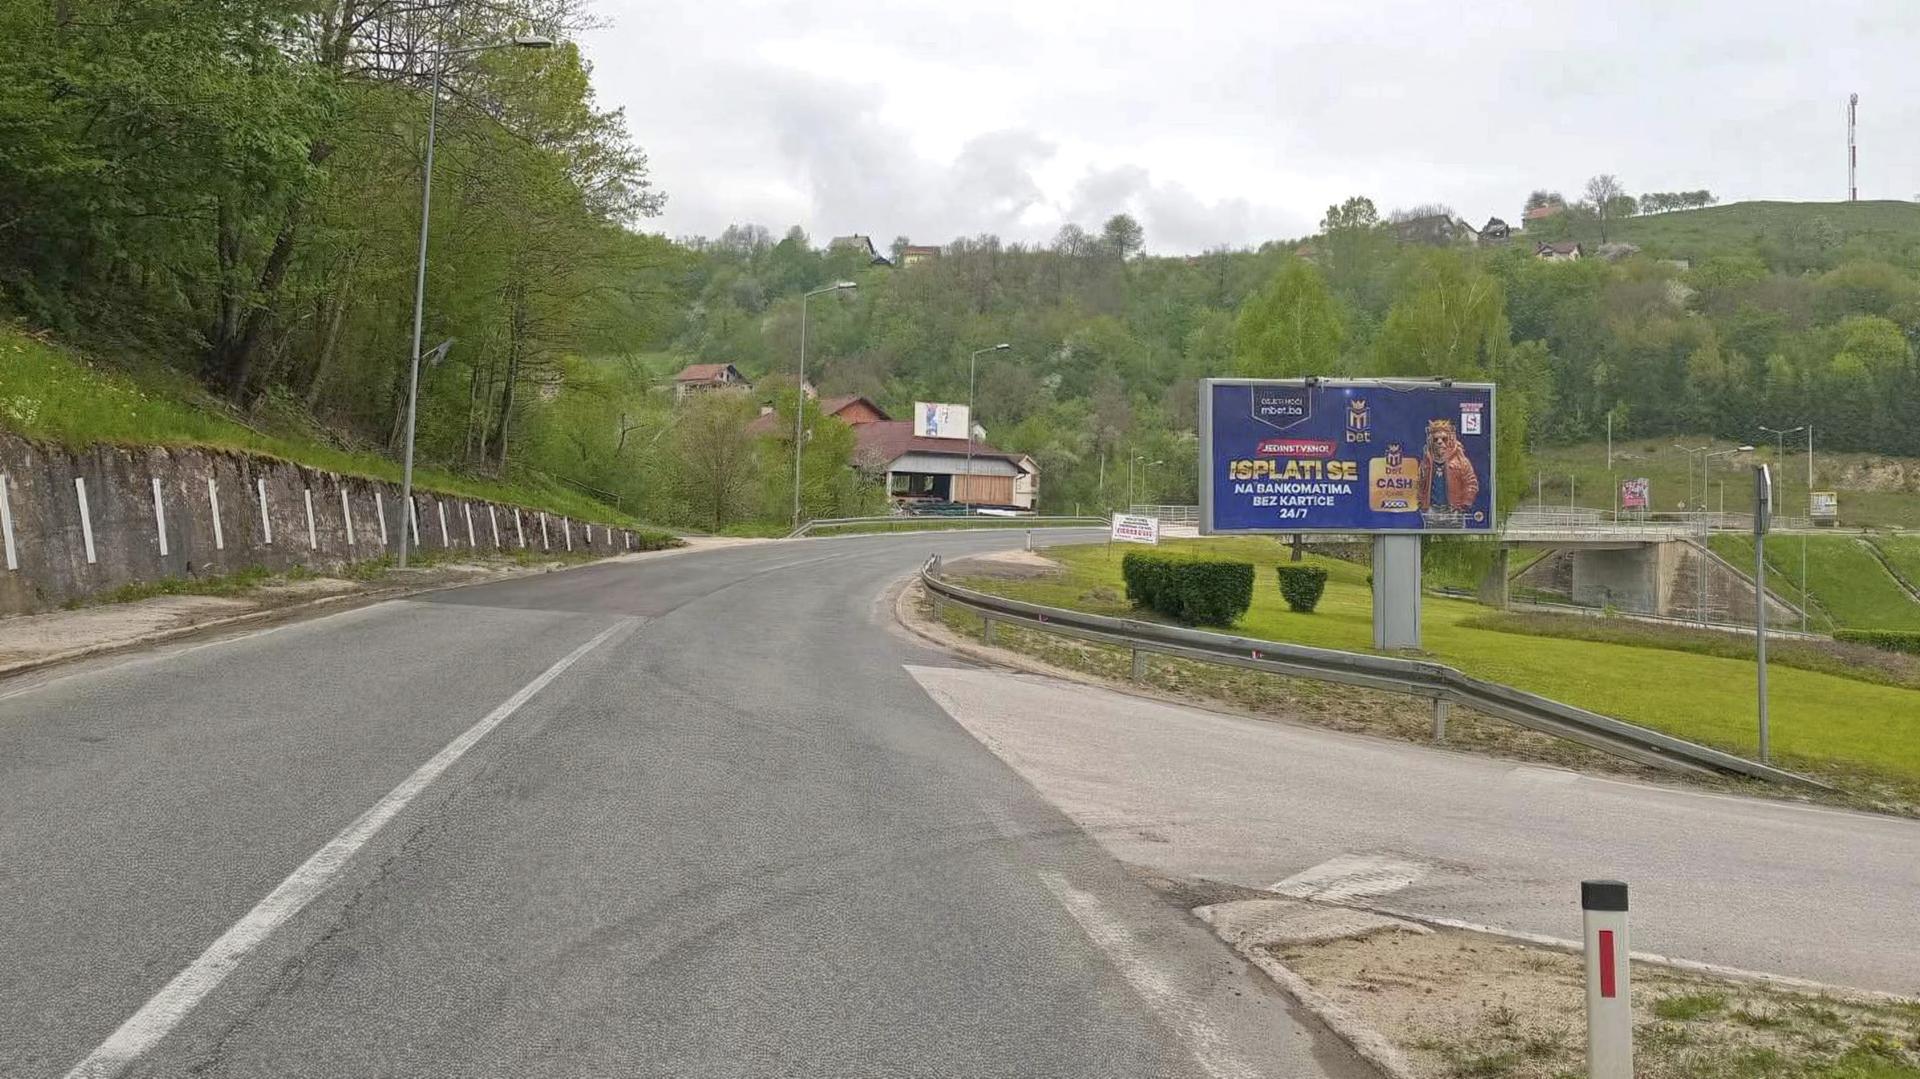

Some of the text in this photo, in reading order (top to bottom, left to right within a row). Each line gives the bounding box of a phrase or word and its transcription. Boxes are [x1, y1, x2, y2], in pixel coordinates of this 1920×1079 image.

[1261, 406, 1303, 415] mbet.ba
[1346, 430, 1371, 442] bet
[1229, 459, 1358, 480] ISPLATI SE
[1234, 483, 1352, 494] NA BANKOMATIMA
[1376, 478, 1412, 489] CASH
[1253, 496, 1335, 506] BEZ KARTICE
[1279, 508, 1307, 518] 24/7
